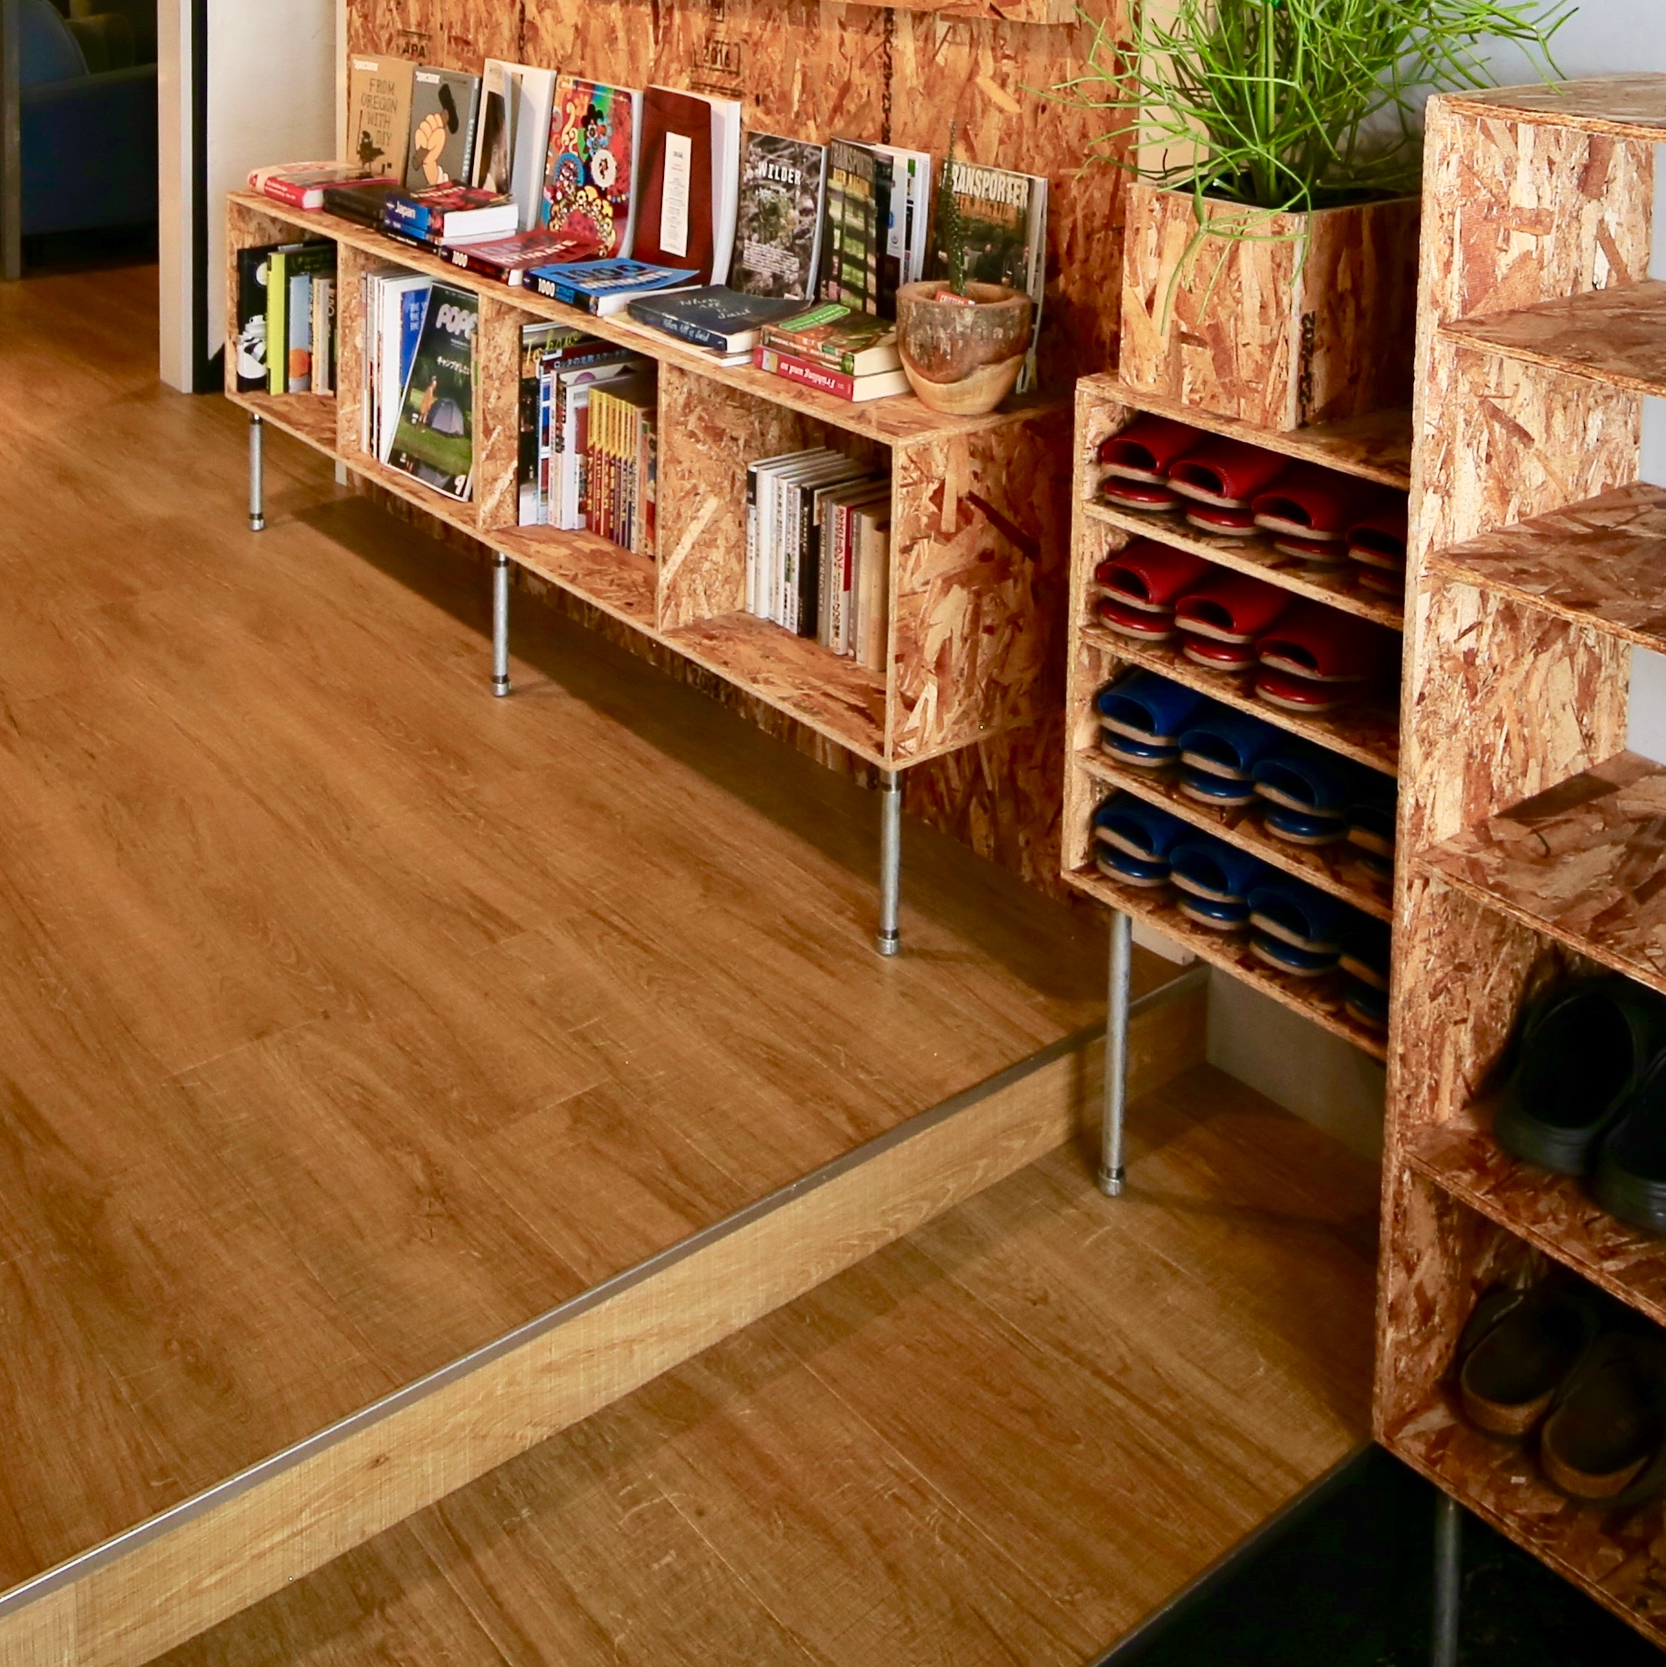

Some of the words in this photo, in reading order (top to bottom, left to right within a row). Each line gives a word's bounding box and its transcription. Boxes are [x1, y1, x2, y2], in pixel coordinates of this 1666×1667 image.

[369, 78, 395, 96] FROM
[758, 161, 802, 186] WILDER
[394, 201, 416, 220] Japan
[452, 250, 468, 268] 1000
[538, 278, 556, 298] 1000
[802, 367, 836, 389] Frühling
